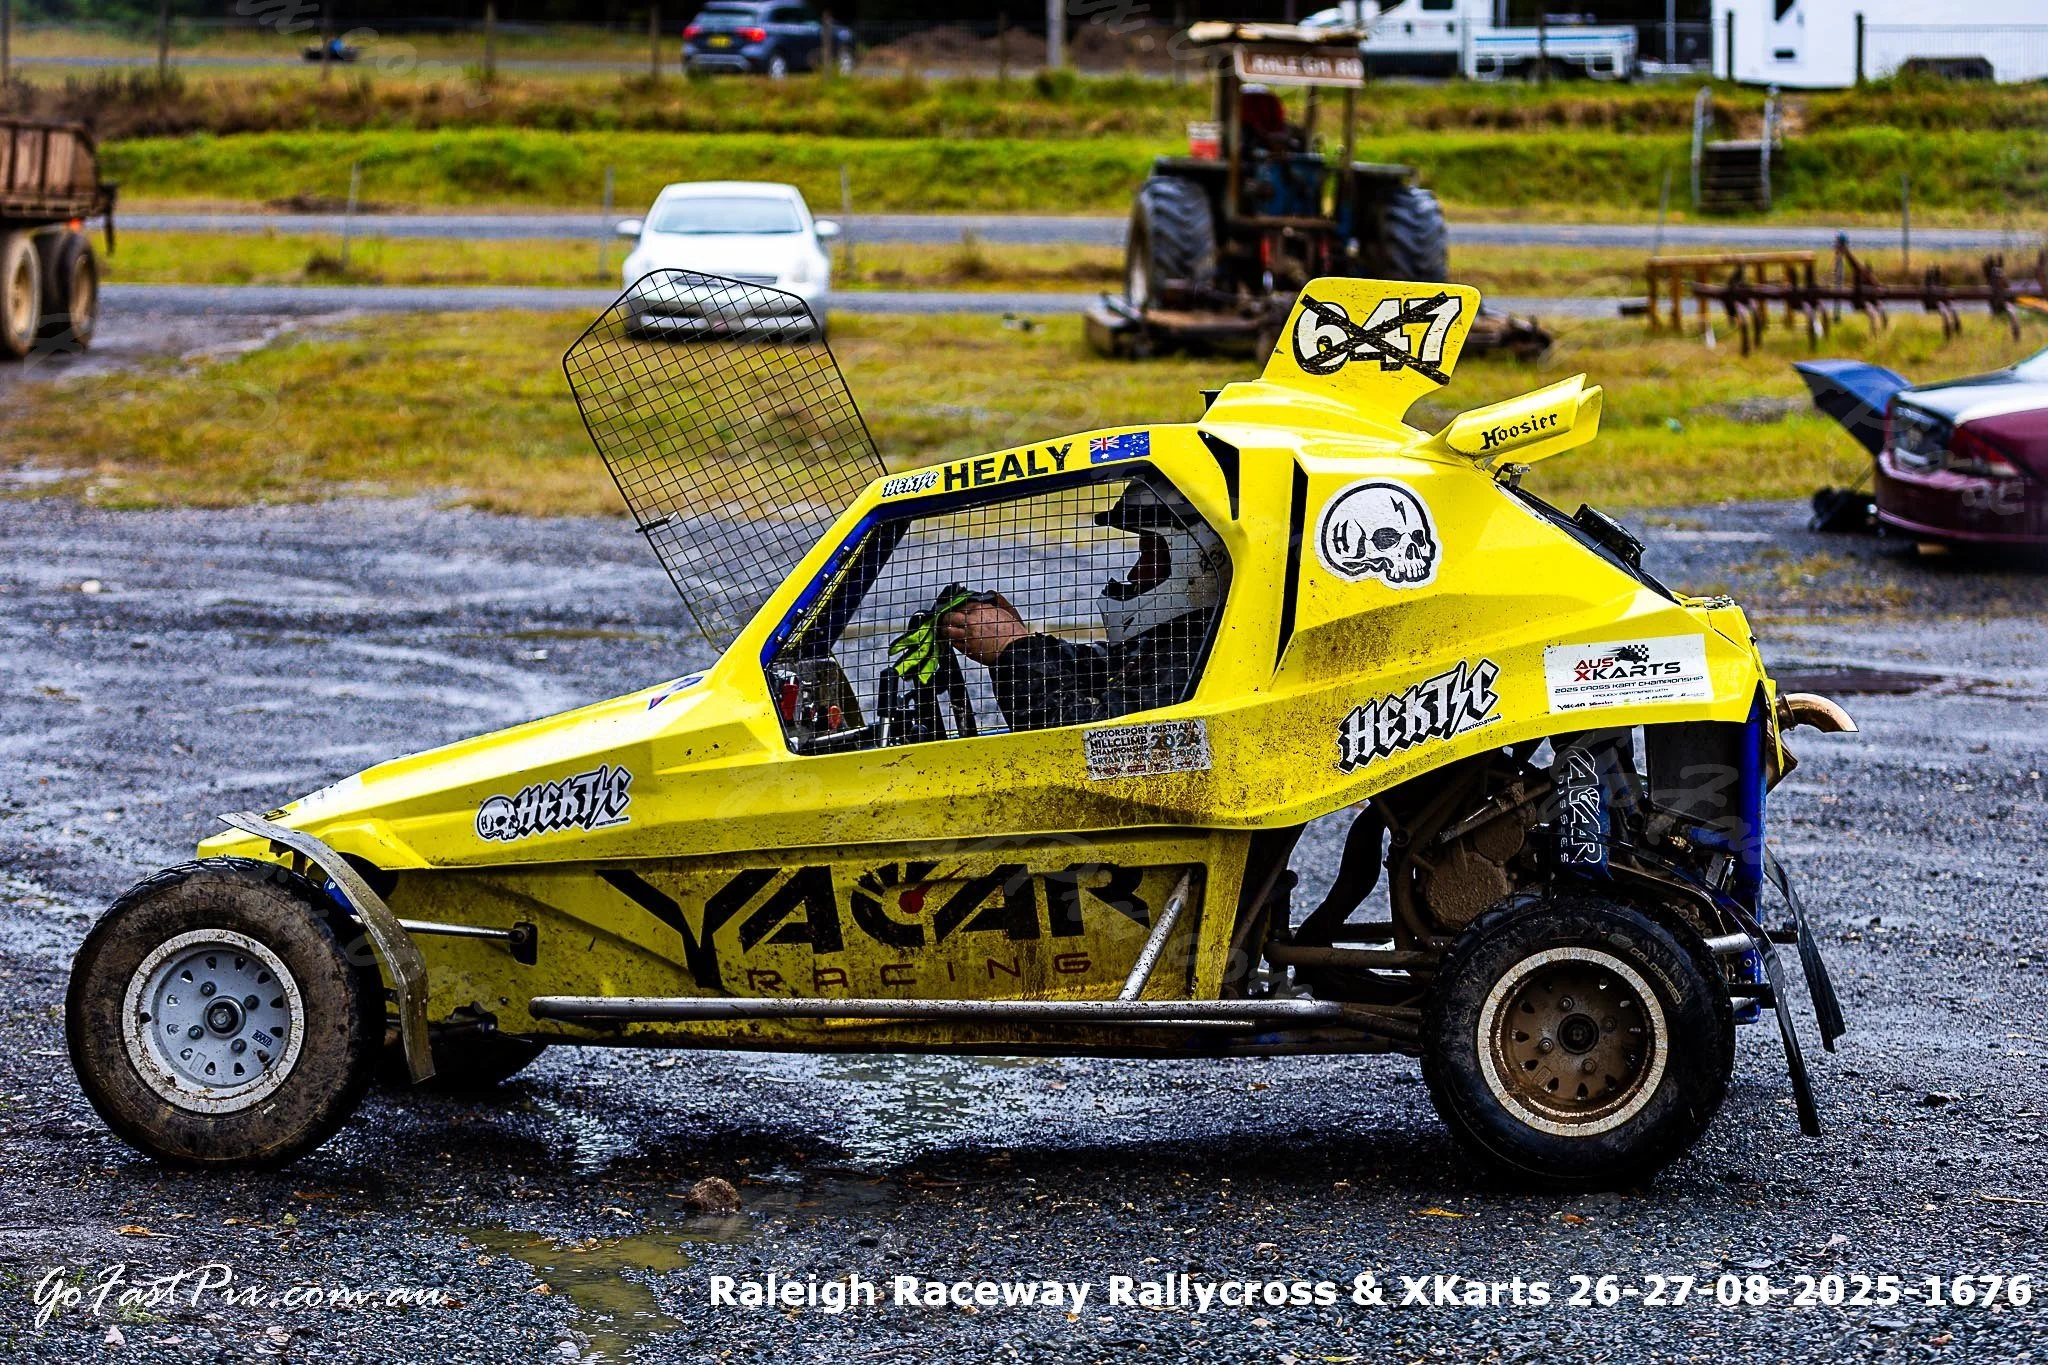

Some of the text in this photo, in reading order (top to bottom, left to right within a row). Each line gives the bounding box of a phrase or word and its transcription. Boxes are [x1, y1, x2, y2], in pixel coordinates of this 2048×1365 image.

[1292, 295, 1462, 375] 647
[1479, 412, 1558, 451] Hoosier
[944, 442, 1073, 492] HEALY
[1573, 661, 1681, 682] XKARTS
[1574, 656, 1615, 671] AUS
[1554, 686, 1579, 694] 2025
[1580, 684, 1611, 692] CROSS
[1088, 721, 1199, 739] MOTORSPORT AUSTRALIA
[1337, 658, 1499, 773] HEKTIC
[1089, 735, 1148, 750] HILLCLIMB
[1090, 745, 1149, 757] CHAMPIONSHIP
[513, 764, 633, 837] HEKTIC
[595, 860, 1151, 988] YACAR
[747, 951, 1092, 992] RACING
